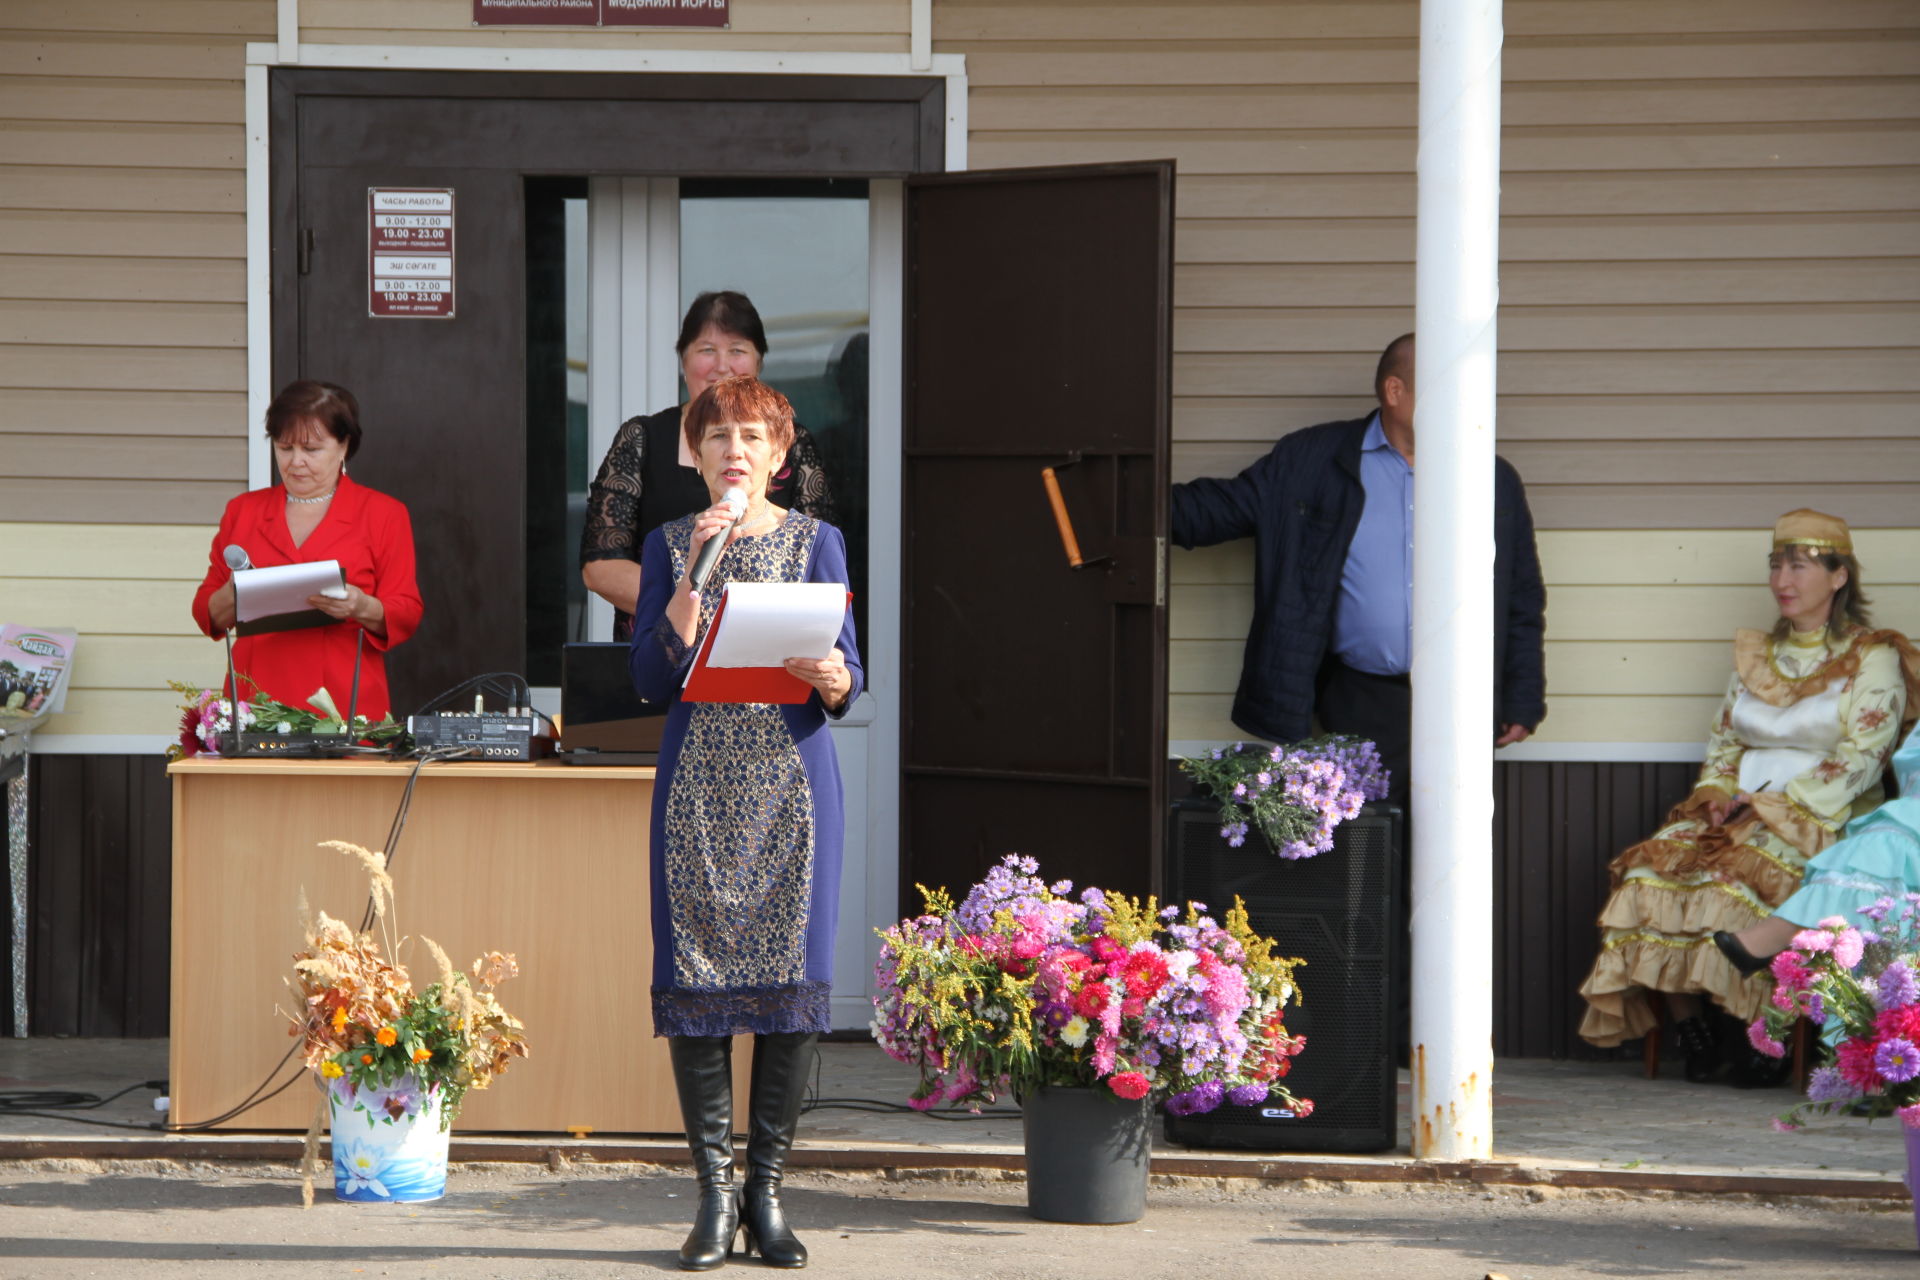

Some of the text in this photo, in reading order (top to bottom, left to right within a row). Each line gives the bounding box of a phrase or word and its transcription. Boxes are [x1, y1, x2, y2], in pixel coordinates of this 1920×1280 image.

[408, 198, 444, 206] РАБОТЫ
[385, 217, 406, 226] 9.00
[416, 217, 441, 226] 12.00
[382, 229, 409, 238] 19.00
[418, 229, 444, 239] 23.00
[384, 281, 405, 290] 9.00
[415, 281, 440, 290] 12.00
[383, 292, 409, 301] 19.00
[416, 292, 443, 302] 23.00
